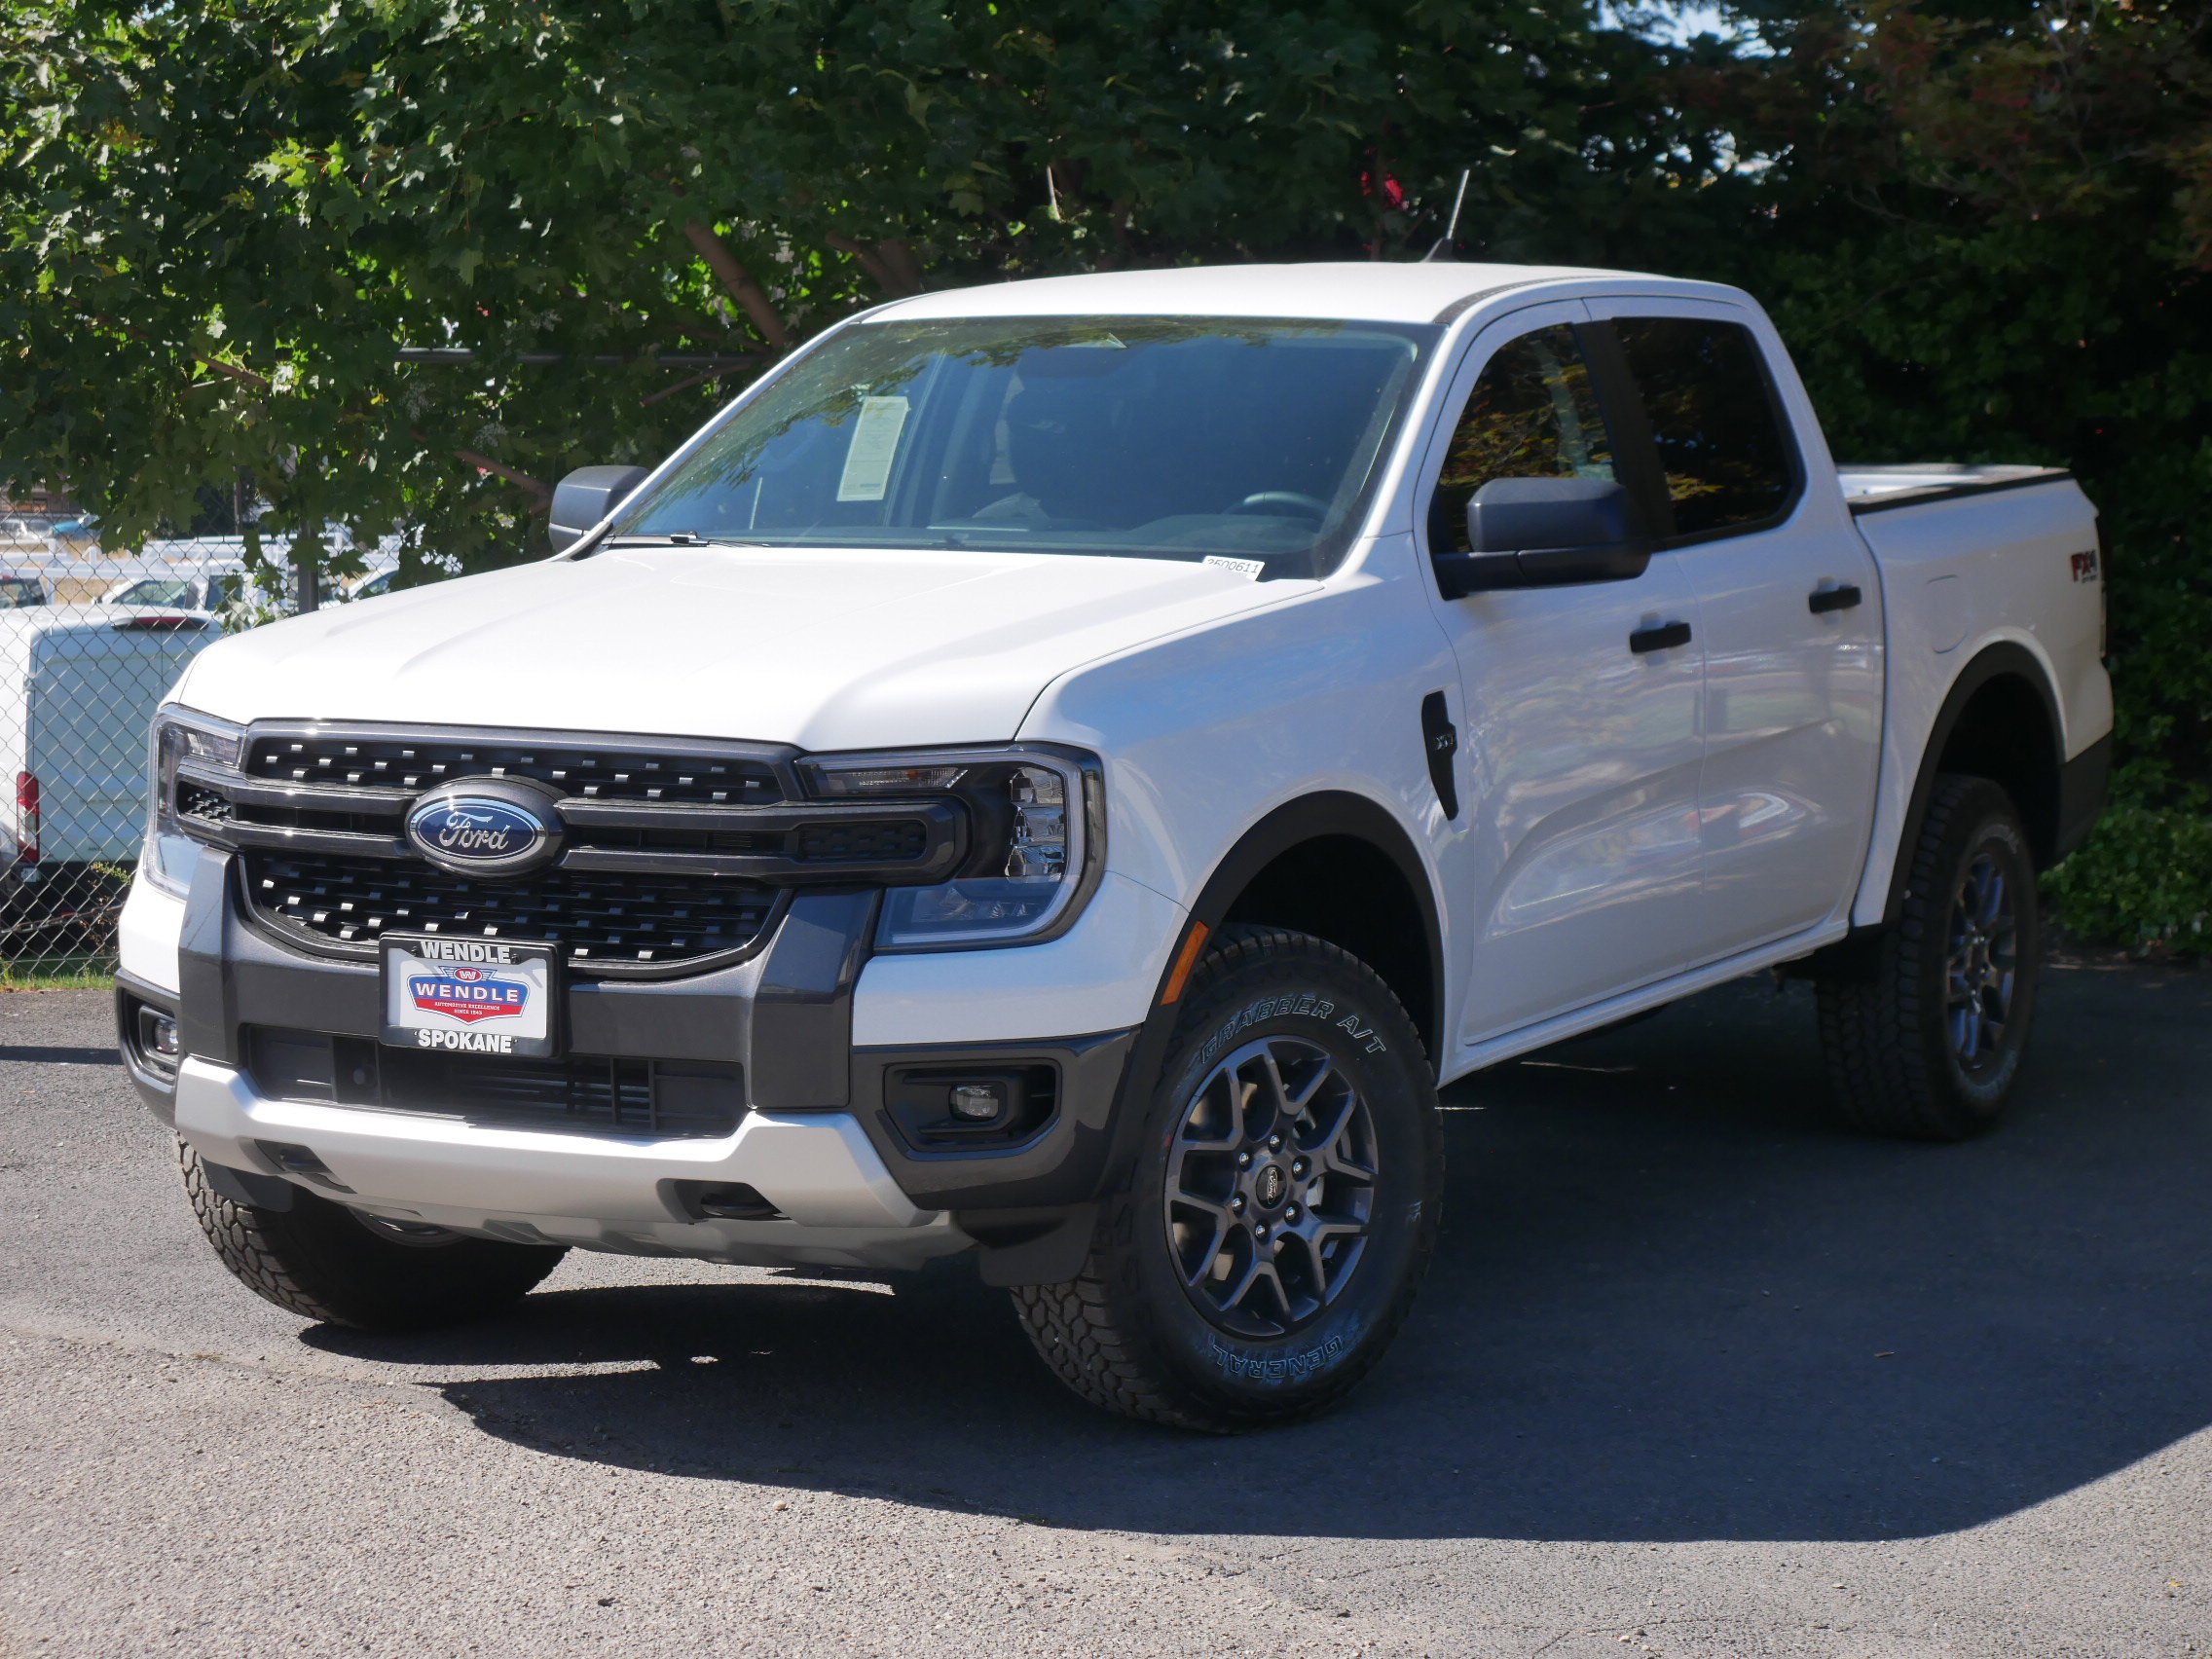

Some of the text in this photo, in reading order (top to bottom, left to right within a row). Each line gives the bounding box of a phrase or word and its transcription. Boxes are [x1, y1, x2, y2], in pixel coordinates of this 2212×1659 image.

[438, 811, 511, 850] Ford
[421, 940, 512, 964] WENDLE
[415, 982, 519, 1003] WENDLE
[418, 1028, 512, 1053] SPOKANE
[1200, 996, 1387, 1064] GRABBER A/T
[1213, 1335, 1344, 1380] GENERAL
